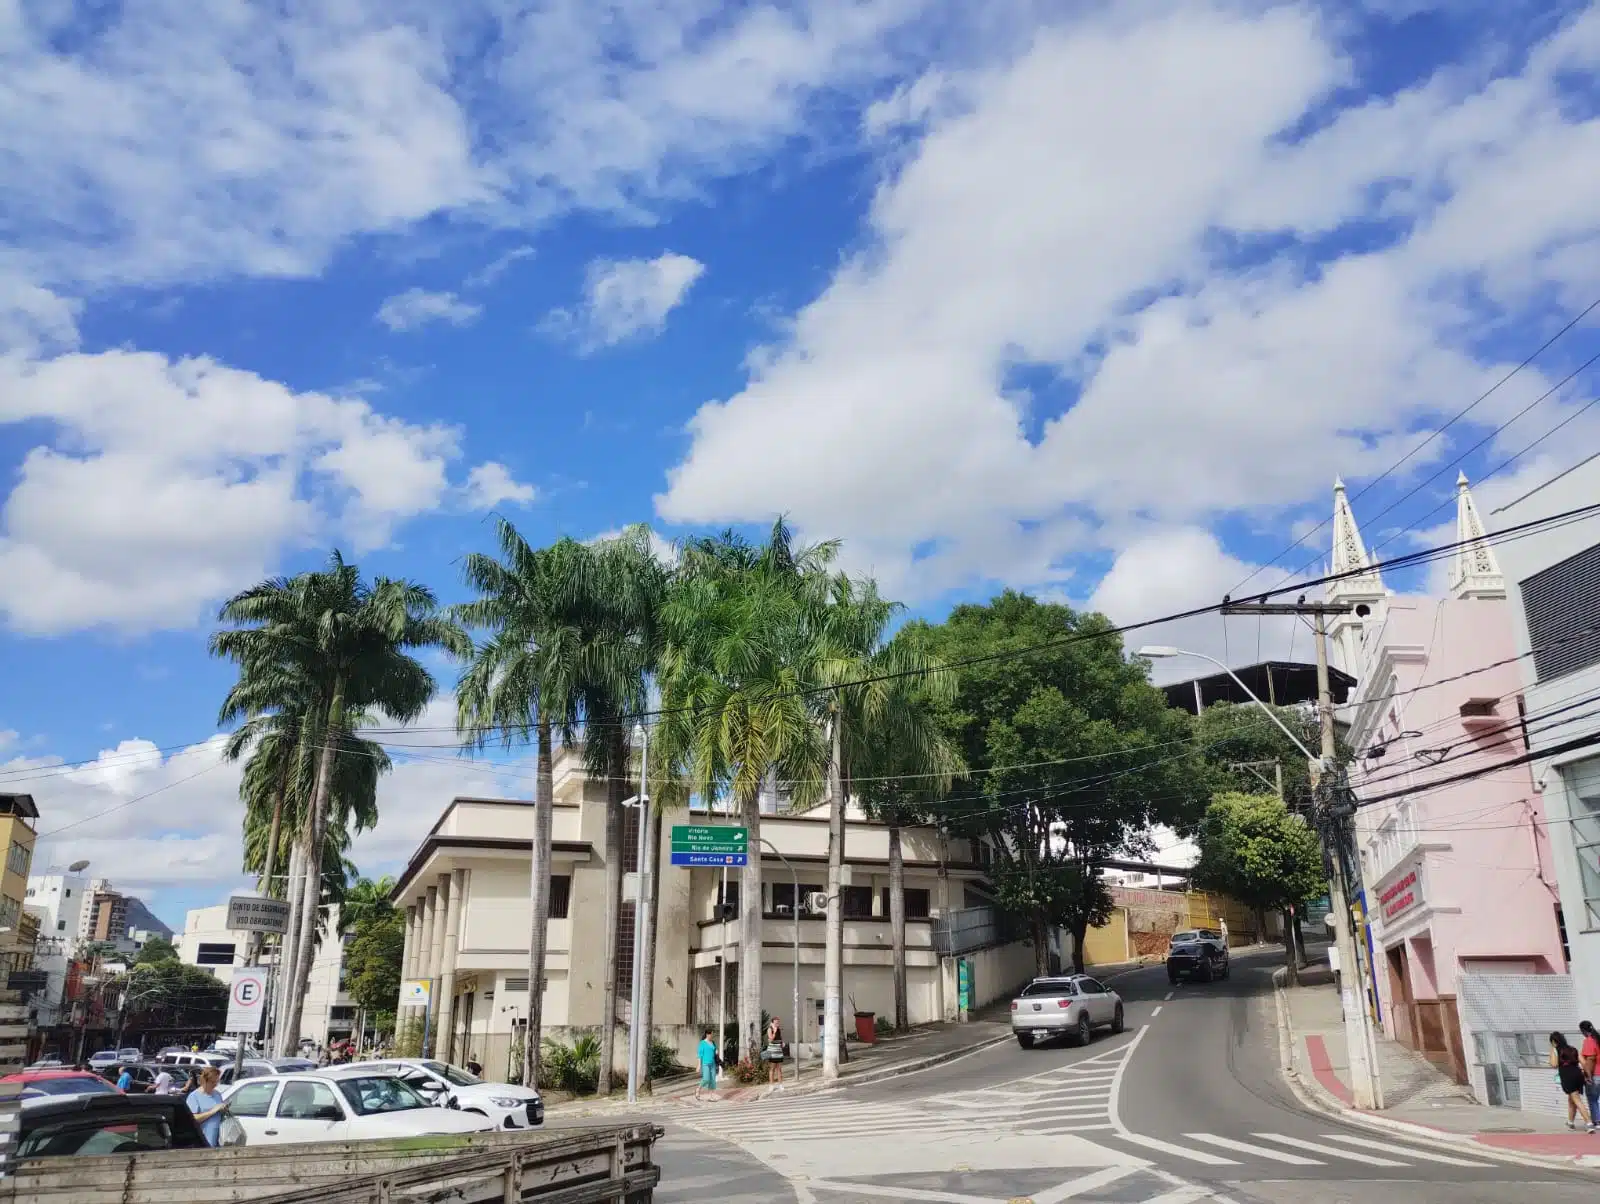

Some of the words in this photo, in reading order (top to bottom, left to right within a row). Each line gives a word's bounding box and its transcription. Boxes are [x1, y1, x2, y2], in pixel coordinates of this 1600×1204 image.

[232, 902, 251, 911] CINTO
[251, 903, 260, 912] DE
[236, 916, 249, 924] USO
[242, 984, 254, 1001] E
